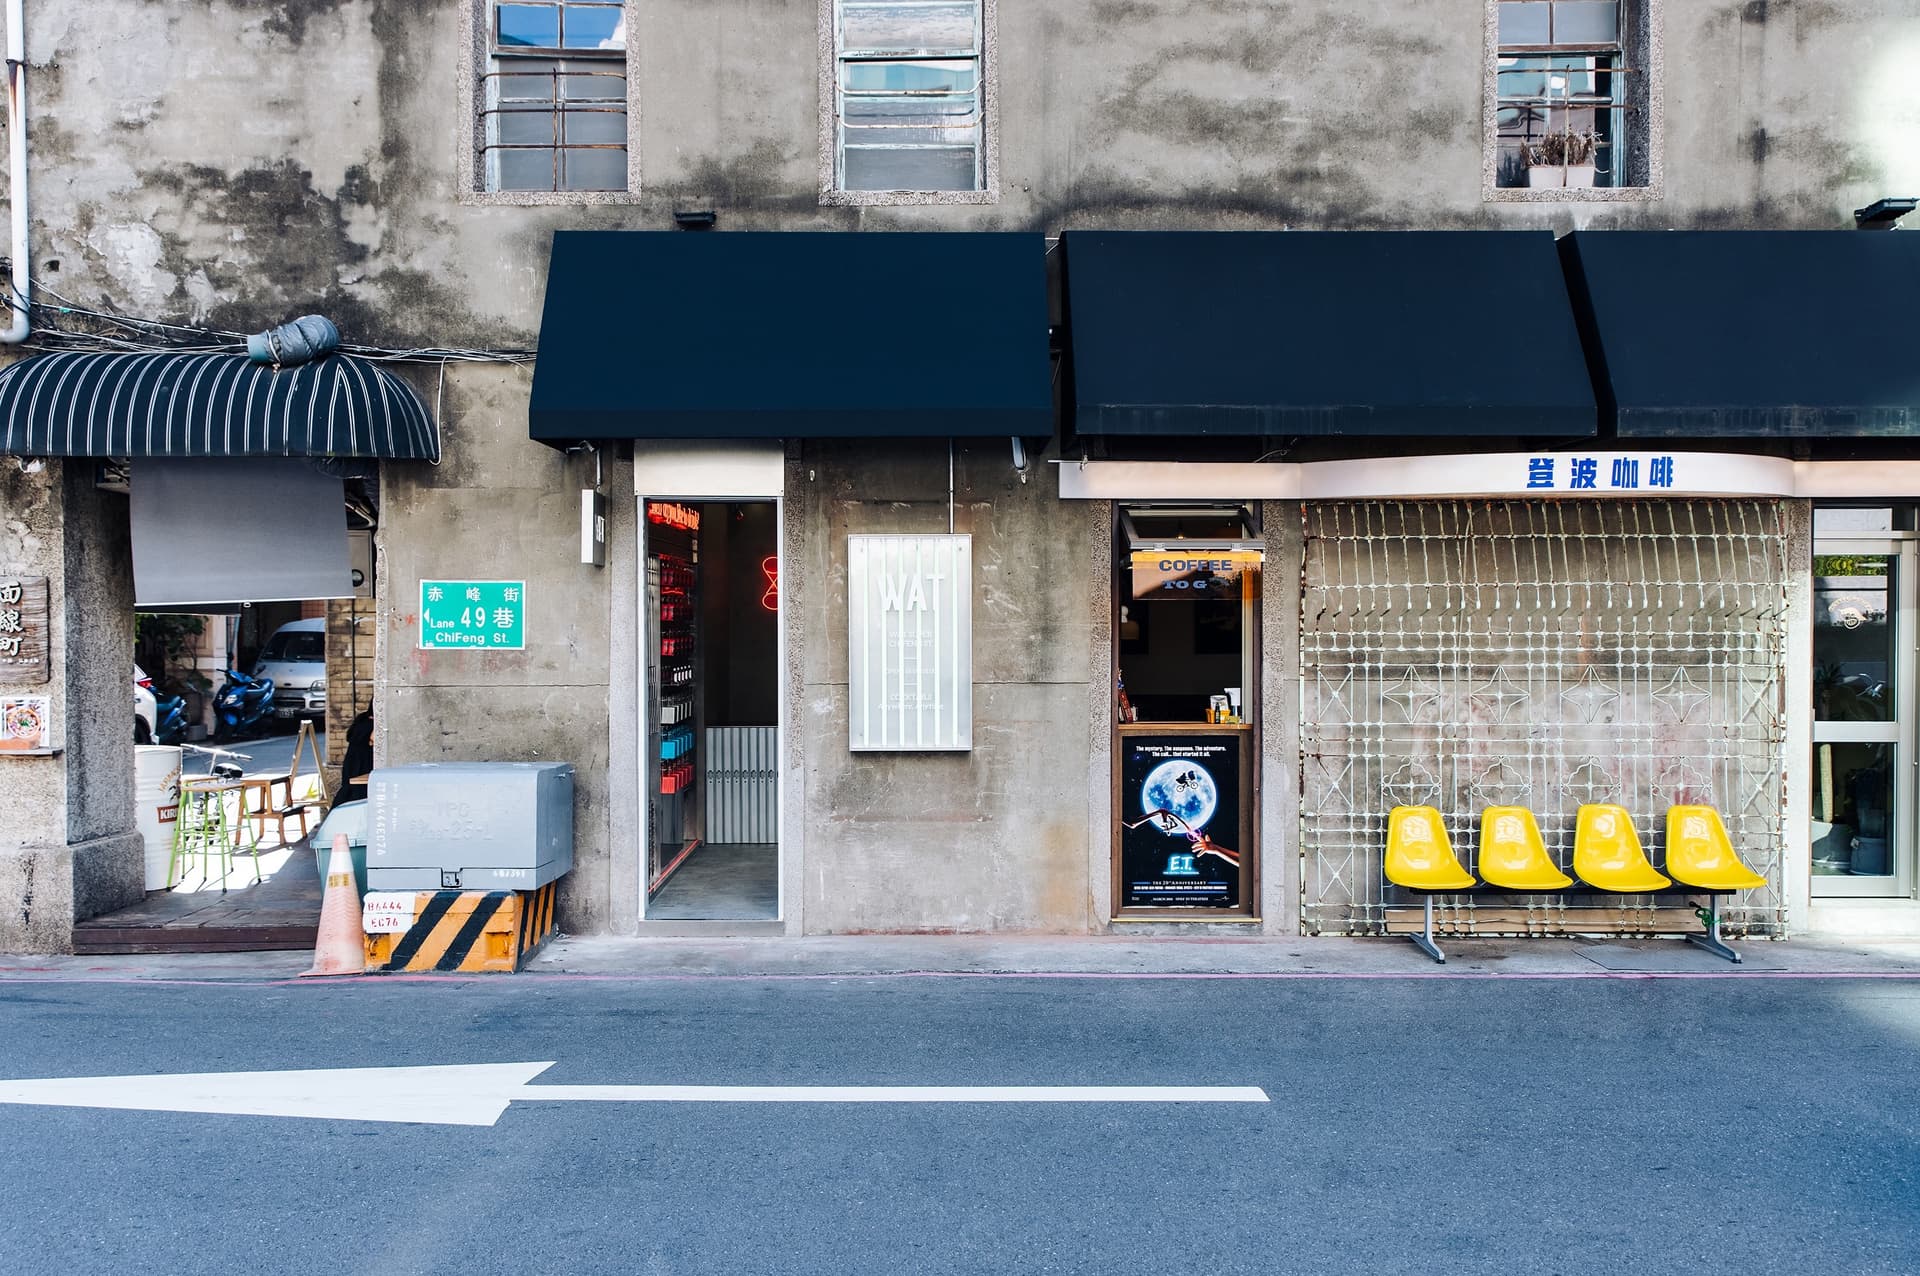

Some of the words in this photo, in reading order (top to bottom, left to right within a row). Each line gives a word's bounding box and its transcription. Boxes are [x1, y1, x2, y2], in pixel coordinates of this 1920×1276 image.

[1527, 456, 1673, 488] 登波咖啡
[1158, 559, 1232, 571] COFFEE
[877, 574, 945, 611] WAT
[1163, 580, 1190, 589] TO
[427, 586, 519, 602] 赤峰街
[430, 617, 455, 629] Lane
[460, 606, 486, 628] 49
[492, 606, 514, 628] 巷
[435, 631, 485, 645] ChiFeng
[493, 632, 509, 643] St.
[1170, 855, 1195, 871] E.T.
